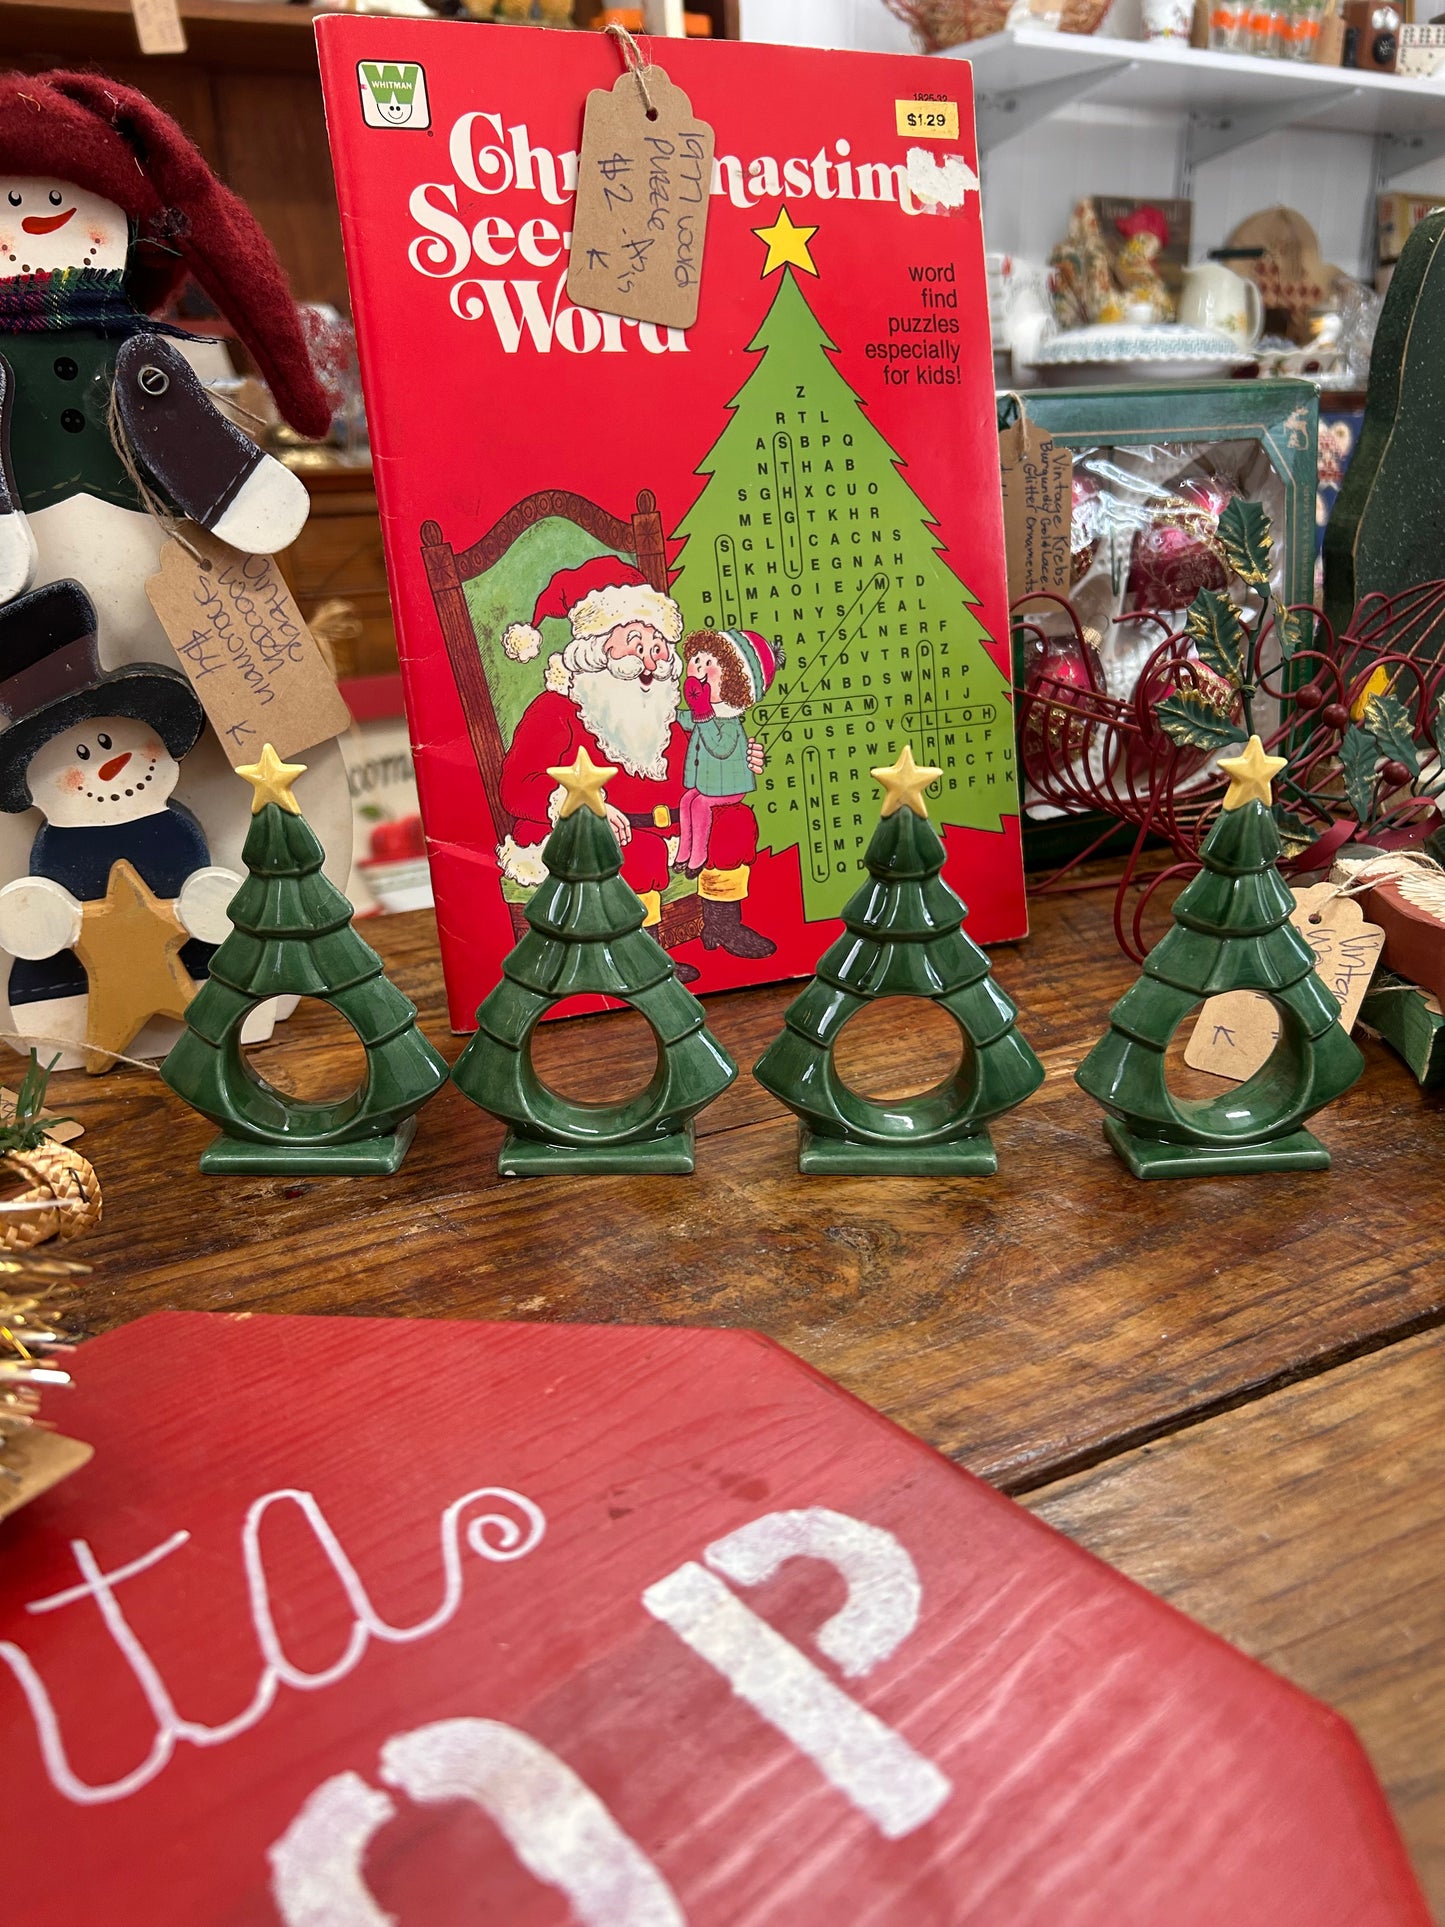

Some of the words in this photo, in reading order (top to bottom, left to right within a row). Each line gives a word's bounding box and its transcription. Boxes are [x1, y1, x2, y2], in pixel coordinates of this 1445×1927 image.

[371, 80, 413, 90] WHITMAN
[907, 113, 946, 127] $1.29
[908, 262, 955, 282] word
[921, 288, 957, 308] find
[888, 313, 960, 337] puzzles
[865, 339, 960, 364] especially
[883, 364, 910, 385] for
[916, 364, 961, 385] kids!
[1036, 440, 1053, 512] Burgundy
[1023, 463, 1037, 514] Glitter
[1048, 454, 1070, 529] Vintage
[1050, 536, 1069, 586] Krebs
